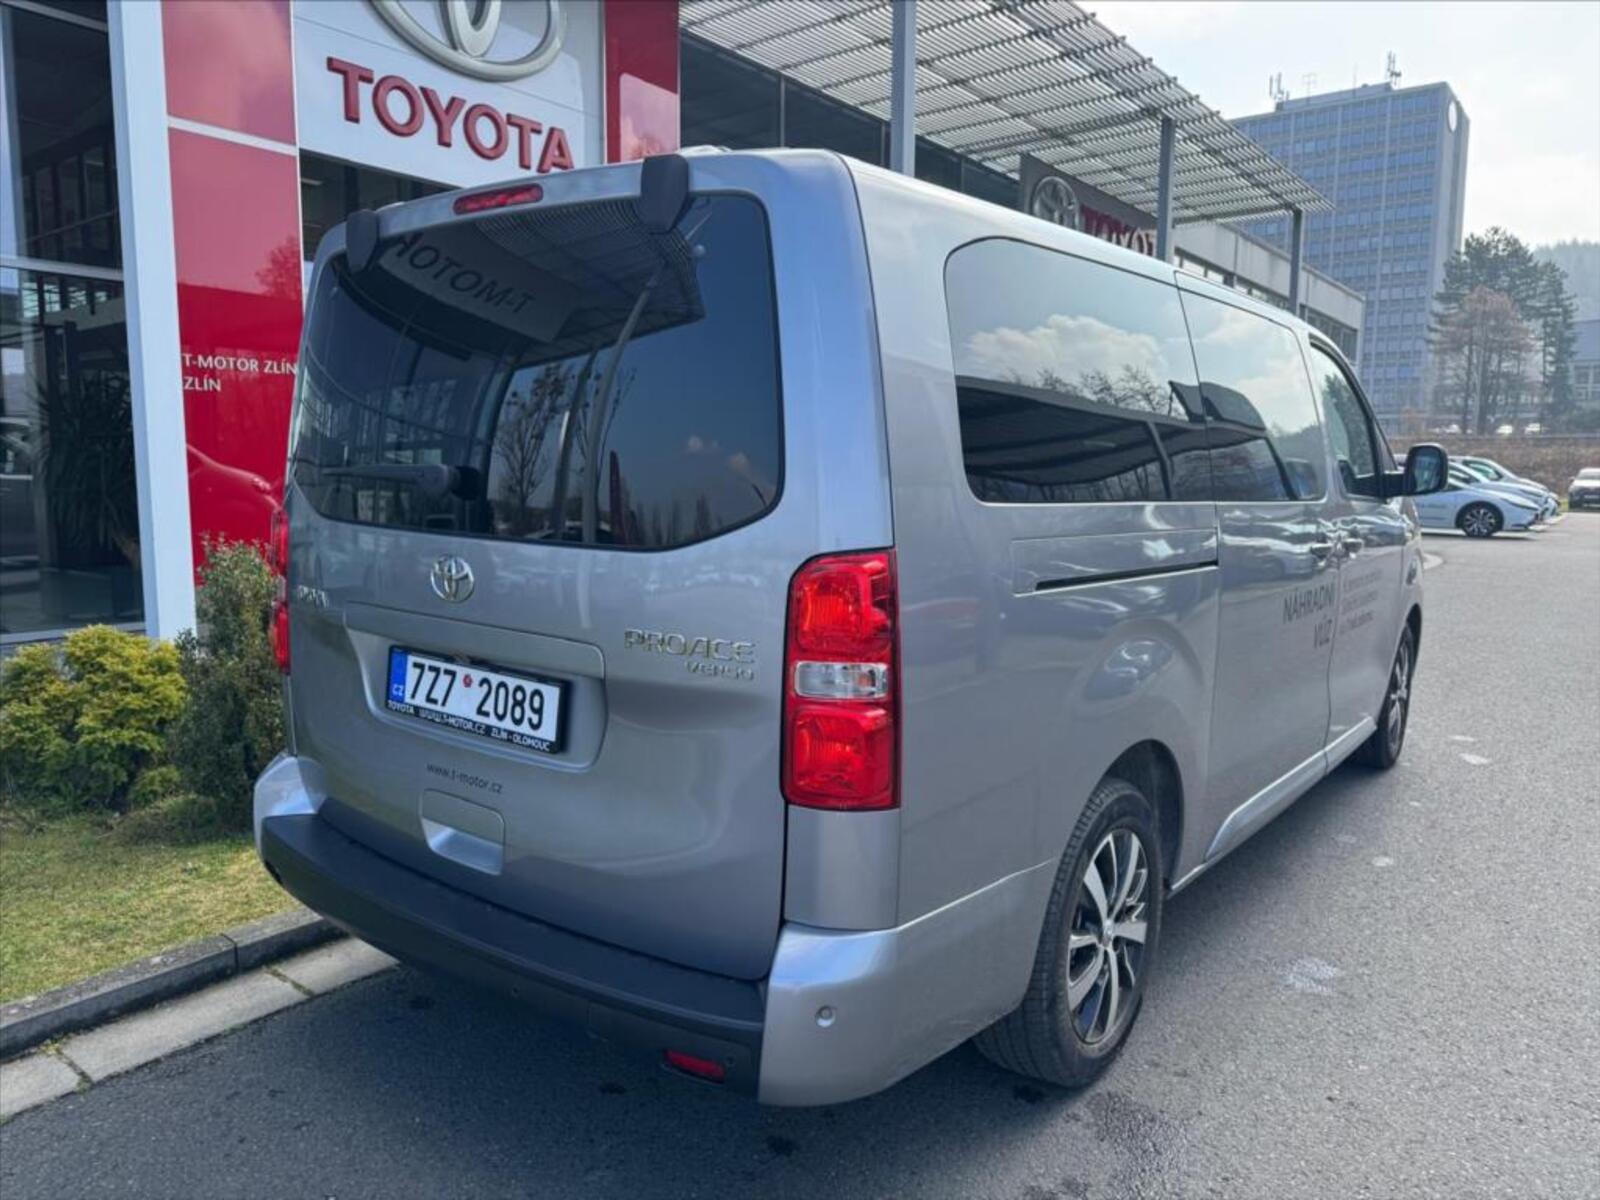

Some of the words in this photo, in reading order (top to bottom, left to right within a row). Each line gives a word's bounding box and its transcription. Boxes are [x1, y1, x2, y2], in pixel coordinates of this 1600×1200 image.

[326, 56, 574, 174] TOYOTA
[182, 353, 259, 373] T-MOTOR
[264, 359, 298, 375] ZLÍN
[184, 374, 221, 392] ZLÍN
[624, 627, 756, 664] PROACE
[392, 684, 404, 696] CZ
[410, 662, 457, 707] 7Z7
[476, 678, 545, 731] 2089
[388, 700, 415, 714] TOYOTA
[512, 733, 550, 752] OLOMOUC
[425, 763, 503, 795] www.t-motor.cz
